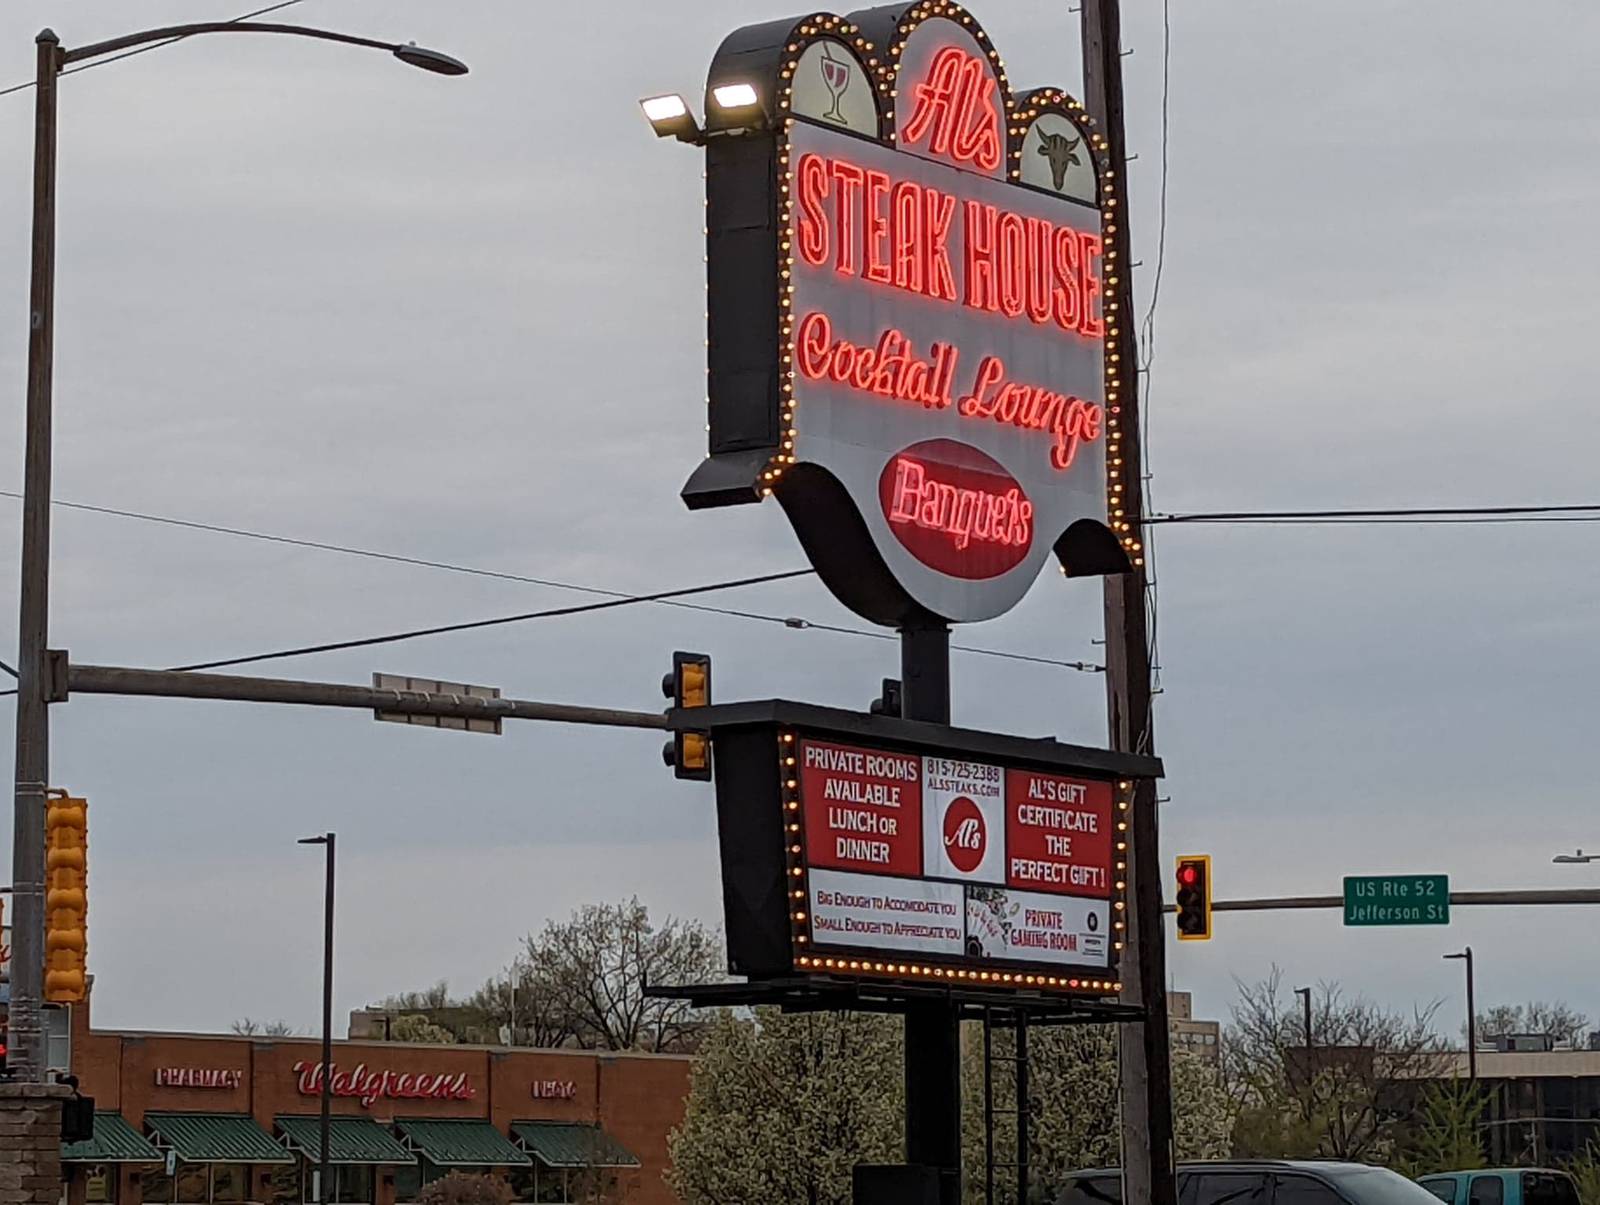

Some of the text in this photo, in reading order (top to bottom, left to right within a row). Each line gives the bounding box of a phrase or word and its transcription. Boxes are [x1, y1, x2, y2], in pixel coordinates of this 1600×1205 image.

[798, 152, 1104, 337] STEAK HOUSE
[799, 312, 1103, 469] Cocktail Lounge
[889, 458, 1033, 550] Banquets
[805, 746, 917, 781] PRIVATE ROOMS
[824, 778, 900, 807] AVAILABLE
[1028, 778, 1086, 805] AL'S GIFT
[829, 807, 897, 835] LUNCH OR
[1018, 804, 1097, 833] CERTIFICATE
[836, 837, 889, 863] DINNER
[1045, 834, 1071, 857] THE
[1011, 857, 1069, 883] PERFECT
[1356, 880, 1435, 897] US Rte 52
[1025, 909, 1062, 930] PRIVATE
[1349, 904, 1444, 921] Jefferson St
[1049, 932, 1077, 952] ROOM
[293, 1061, 476, 1107] Walgreens
